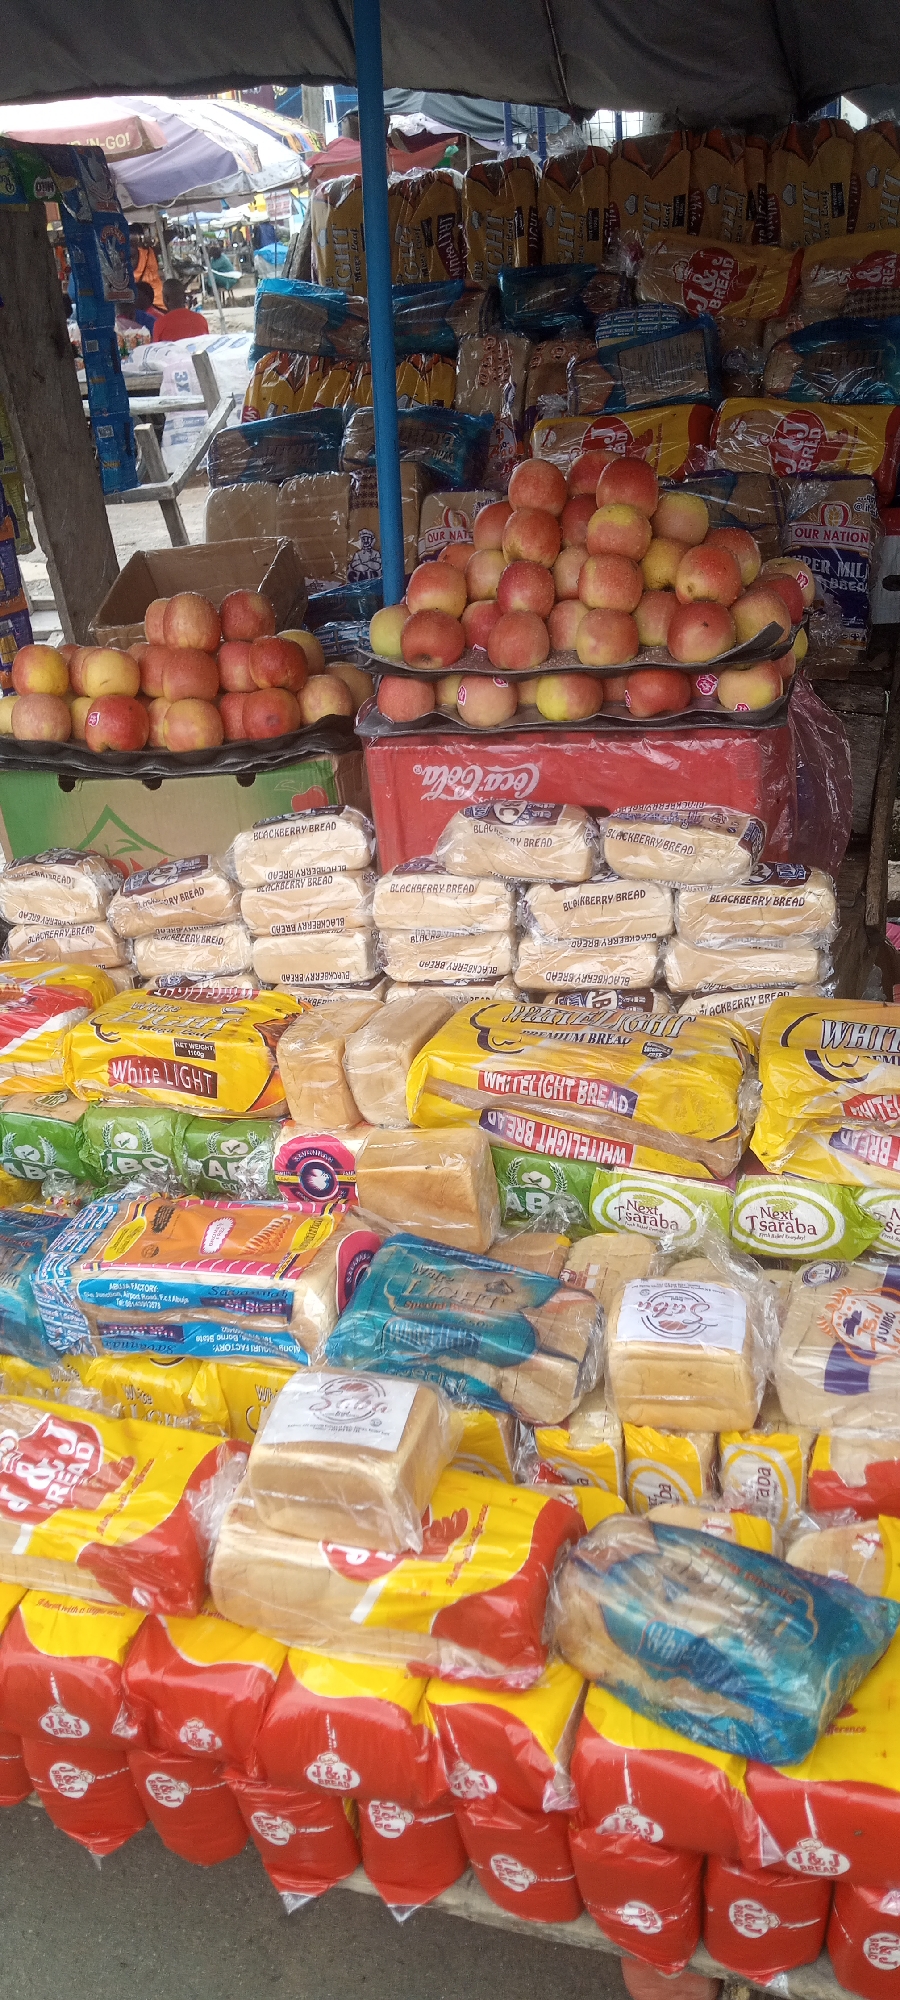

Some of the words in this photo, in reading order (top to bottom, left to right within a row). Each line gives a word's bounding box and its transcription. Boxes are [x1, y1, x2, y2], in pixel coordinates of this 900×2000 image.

[427, 531, 446, 543] OUR
[794, 527, 819, 538] OUR
[823, 530, 870, 544] NATION
[253, 824, 307, 842] BLACKBERRY
[308, 821, 337, 833] BREAD
[523, 838, 552, 847] BREAD
[605, 828, 661, 849] BLACKBERRY
[662, 841, 694, 854] BREAD
[267, 869, 294, 881] BREAD
[307, 875, 333, 887] BREAD
[180, 887, 205, 902] BREAD
[389, 883, 445, 893] BLACKBERRY
[445, 884, 475, 893] BREAD
[615, 890, 646, 902] BREAD
[708, 894, 771, 906] BLACKBERRY
[772, 896, 806, 907] BREAD
[18, 910, 40, 923] BREAD
[71, 925, 96, 936] BREAD
[271, 924, 296, 935] BREAD
[297, 917, 346, 932] BLACKBERRY
[571, 939, 600, 949] BREAD
[419, 959, 446, 970] BREAD
[446, 961, 498, 975] BLACKBERRY
[545, 971, 574, 984] BREAD
[575, 973, 630, 987] BLACKBERRY
[131, 1001, 180, 1013] White
[112, 1060, 160, 1085] White
[165, 1062, 213, 1094] LIGHT
[483, 1070, 575, 1101] WHITELIGHT
[577, 1082, 629, 1114] BREAD
[488, 1111, 536, 1149] BREAD
[537, 1120, 627, 1167] WHITELIGHT
[627, 1199, 659, 1215] Next
[760, 1206, 794, 1221] Next
[614, 1205, 680, 1231] Tsaraba
[745, 1215, 818, 1236] Tsaraba
[637, 1301, 719, 1328] Saba
[876, 1311, 897, 1343] JUMBO
[195, 1335, 215, 1343] State
[213, 1343, 250, 1353] FACTORY:
[0, 1489, 32, 1513] J
[16, 1455, 60, 1490] &
[44, 1420, 79, 1455] J
[45, 1716, 55, 1729] J
[58, 1714, 71, 1729] &
[74, 1717, 83, 1729] J
[52, 1729, 82, 1738] BREAD
[312, 1765, 321, 1778] J
[325, 1766, 340, 1781] &
[343, 1768, 352, 1782] J
[317, 1778, 351, 1789] BREAD
[792, 1852, 803, 1866] J
[808, 1852, 826, 1867] &
[830, 1853, 842, 1868] J
[800, 1865, 838, 1875] BREAD
